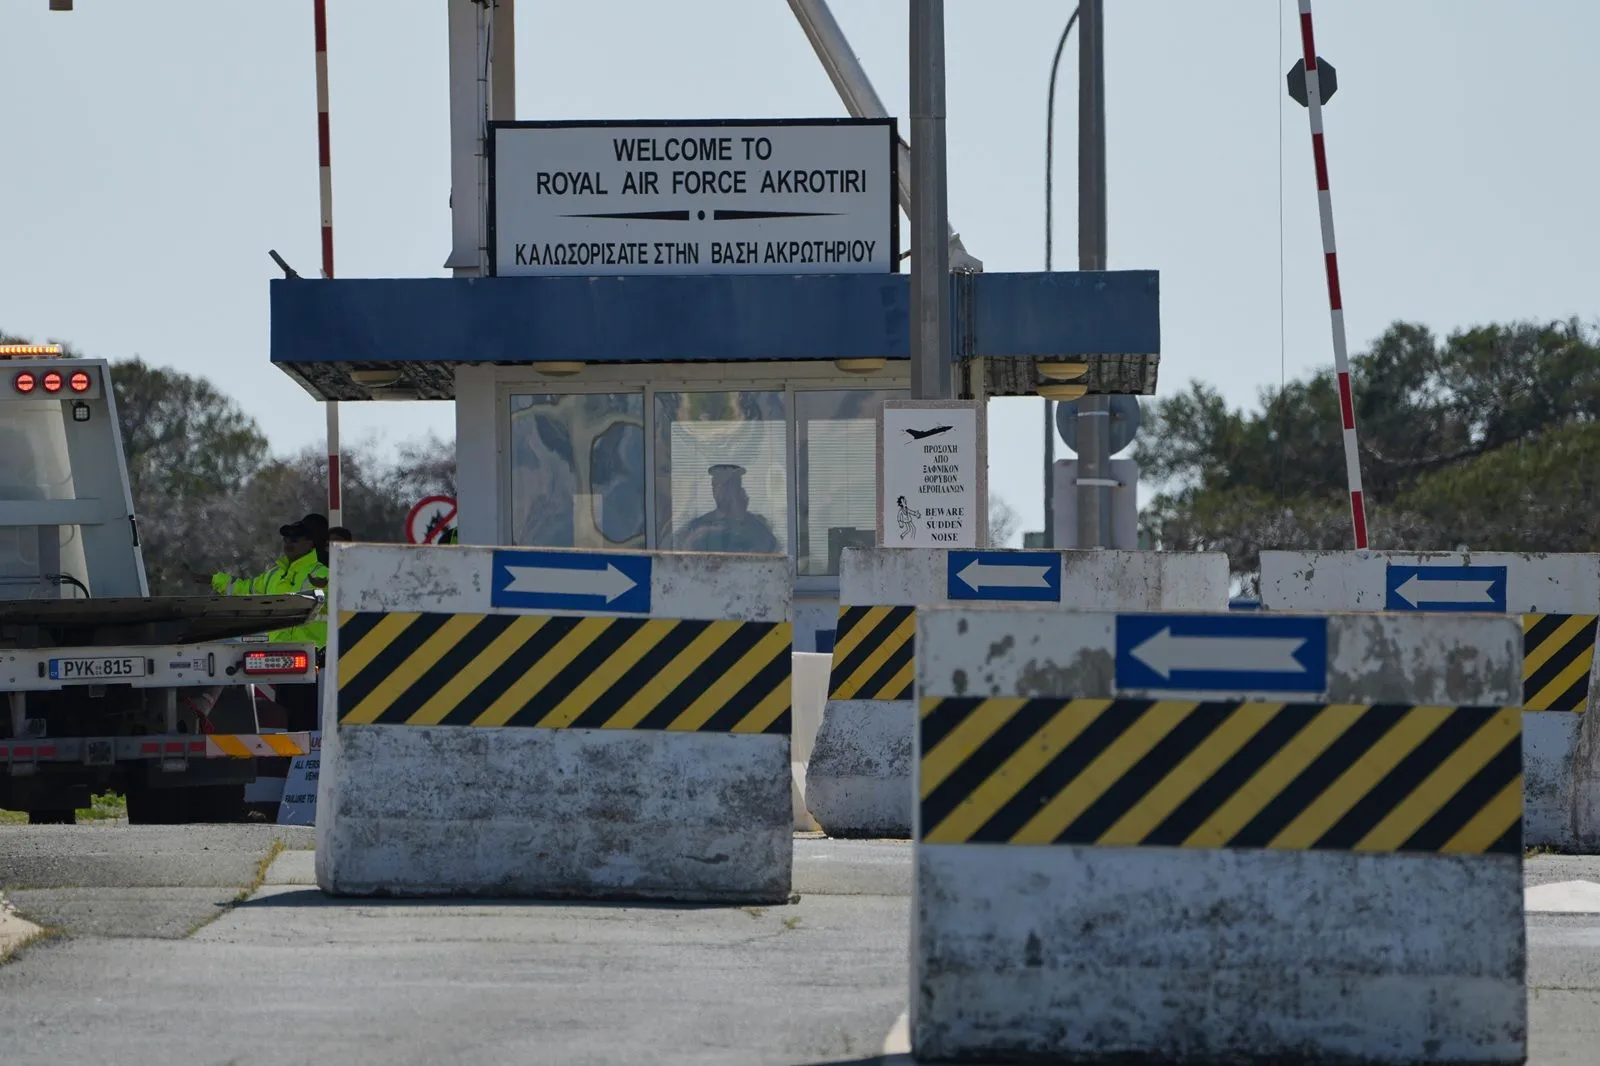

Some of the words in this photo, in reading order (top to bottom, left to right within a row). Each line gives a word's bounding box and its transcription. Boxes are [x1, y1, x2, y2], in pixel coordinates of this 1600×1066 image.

[613, 138, 732, 162] WELCOME
[741, 137, 772, 161] TO
[536, 172, 608, 195] ROYAL
[621, 171, 660, 195] AIR
[672, 170, 747, 194] FORCE
[760, 169, 866, 193] AKROTIRI
[515, 242, 648, 266] ΚΑΛΩΣΟΡΙΣΑΤΕ
[653, 242, 699, 265] ΣΤΗΝ
[711, 241, 759, 265] ΒΑΣΗ
[764, 240, 876, 265] ΑΚΡΩΤΗΡΙΟΥ
[923, 445, 958, 454] ΠΡΟΣΟΧΗ
[933, 454, 949, 464] ΑΠΟ
[925, 507, 965, 517] BEWARE
[926, 520, 963, 530] SUDDEN
[931, 532, 959, 542] NOISE
[63, 660, 95, 677] PYK
[103, 659, 133, 675] 815
